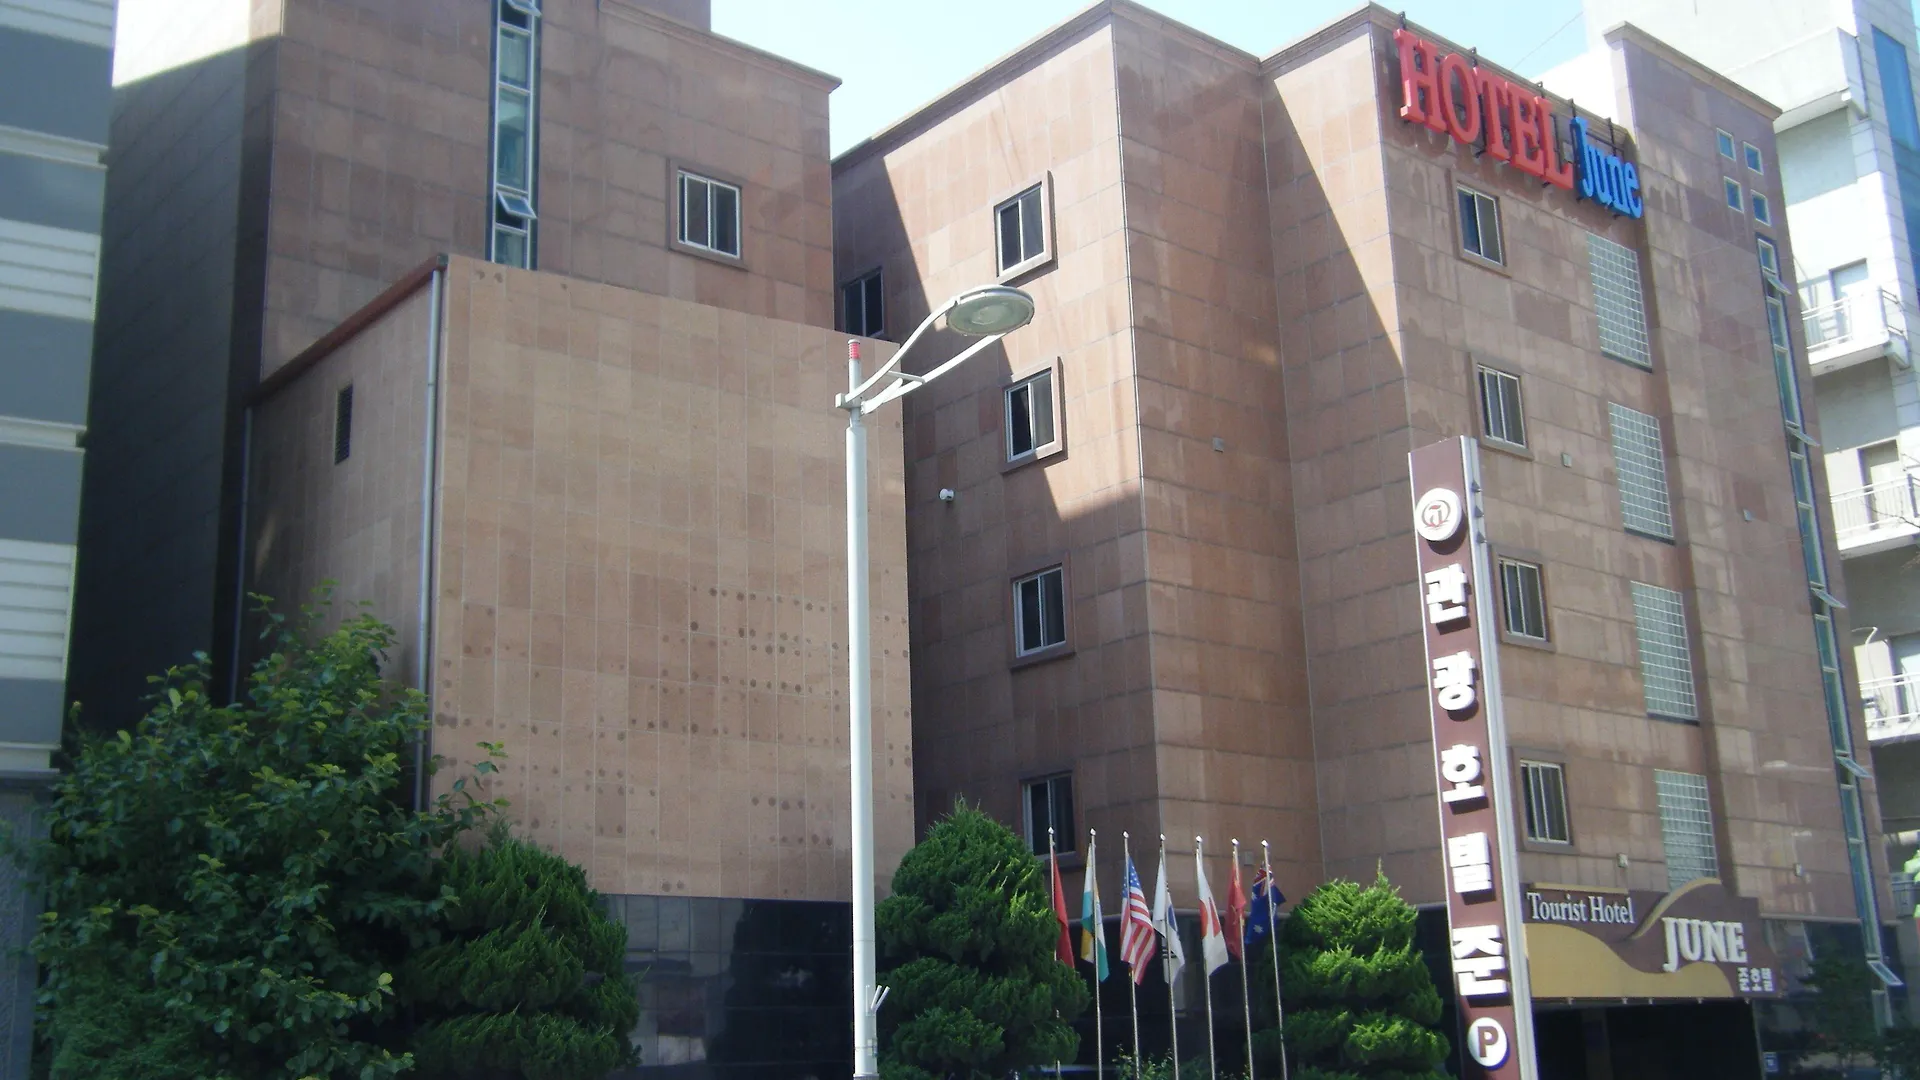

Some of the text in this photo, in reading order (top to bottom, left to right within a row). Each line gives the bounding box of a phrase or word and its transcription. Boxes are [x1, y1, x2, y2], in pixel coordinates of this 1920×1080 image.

[1393, 28, 1643, 219] HOTEL June
[1527, 892, 1635, 924] Tourist Hotel
[1662, 917, 1747, 972] JUNE
[1479, 1025, 1499, 1058] P
